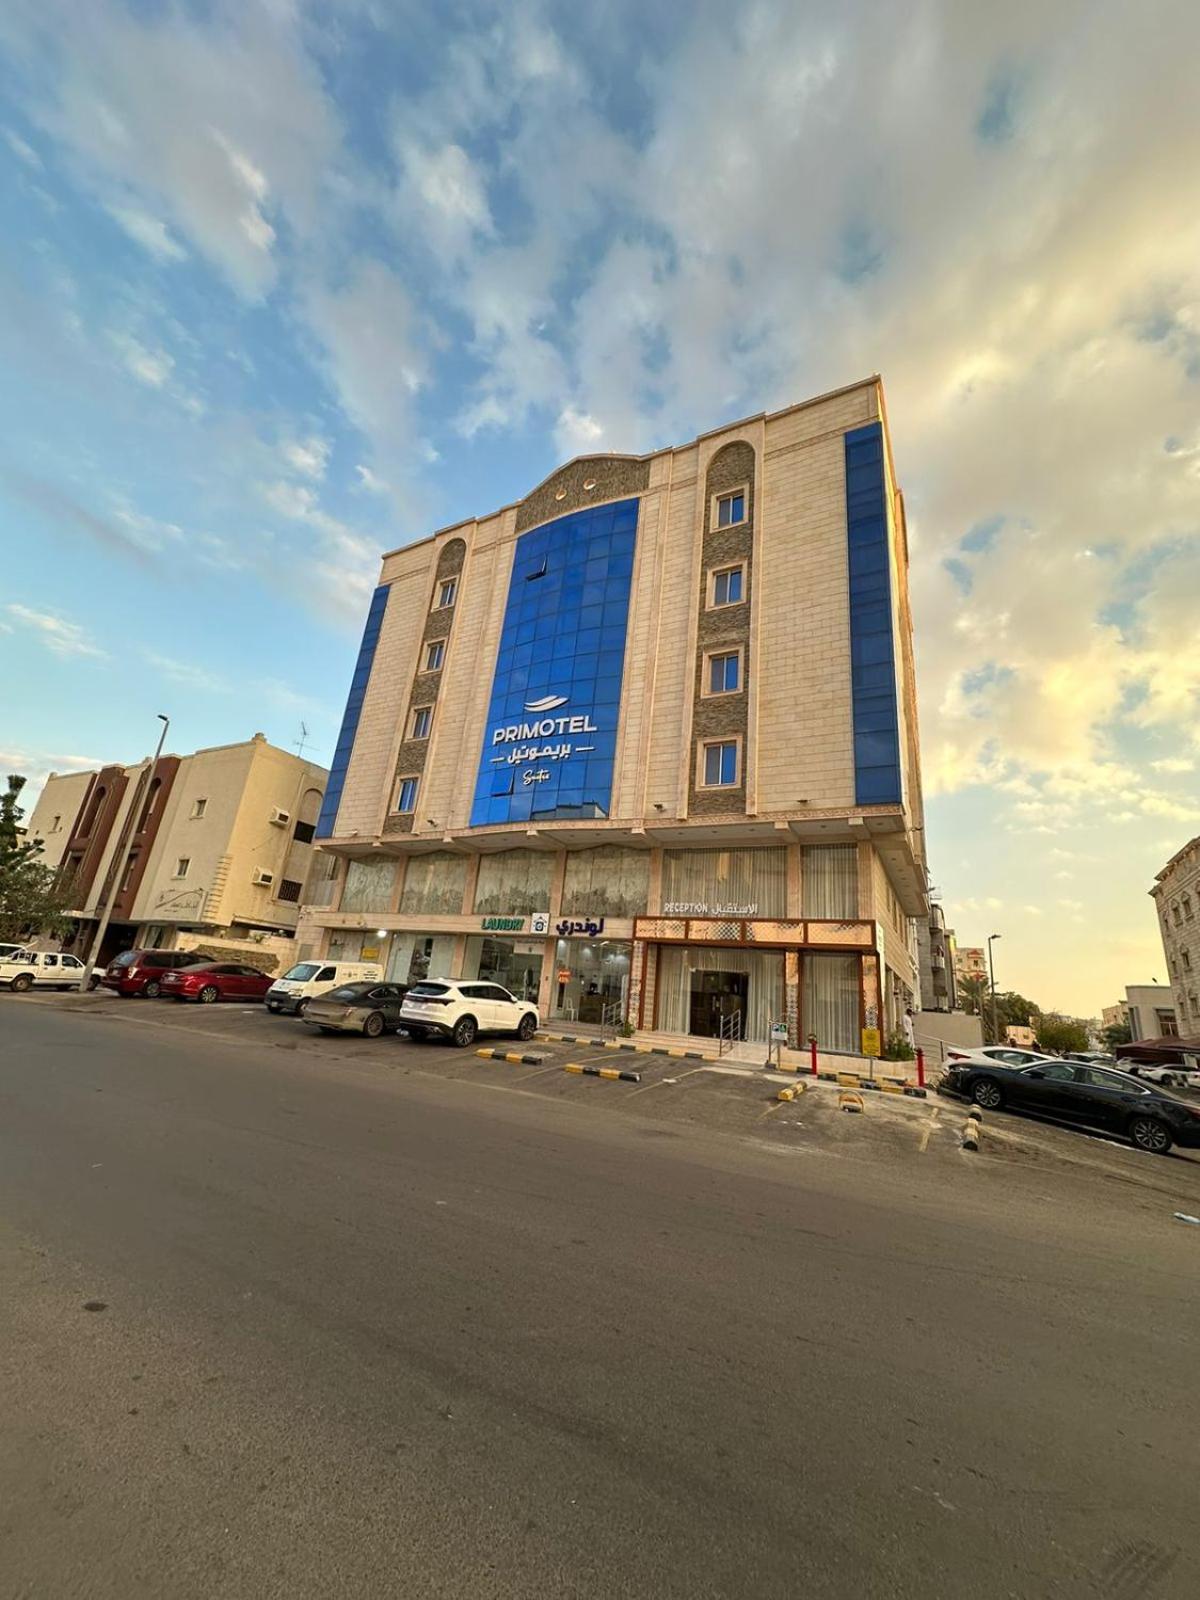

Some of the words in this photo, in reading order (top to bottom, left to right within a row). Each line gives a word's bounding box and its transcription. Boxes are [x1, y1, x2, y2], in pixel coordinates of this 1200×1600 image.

[493, 715, 597, 745] PRIMOTEL
[507, 743, 571, 764] بريموتيل
[664, 902, 708, 912] RECEPTION
[711, 903, 758, 915] الاستقبال
[481, 918, 525, 931] LAUNDRY
[556, 917, 604, 936] لوندري
